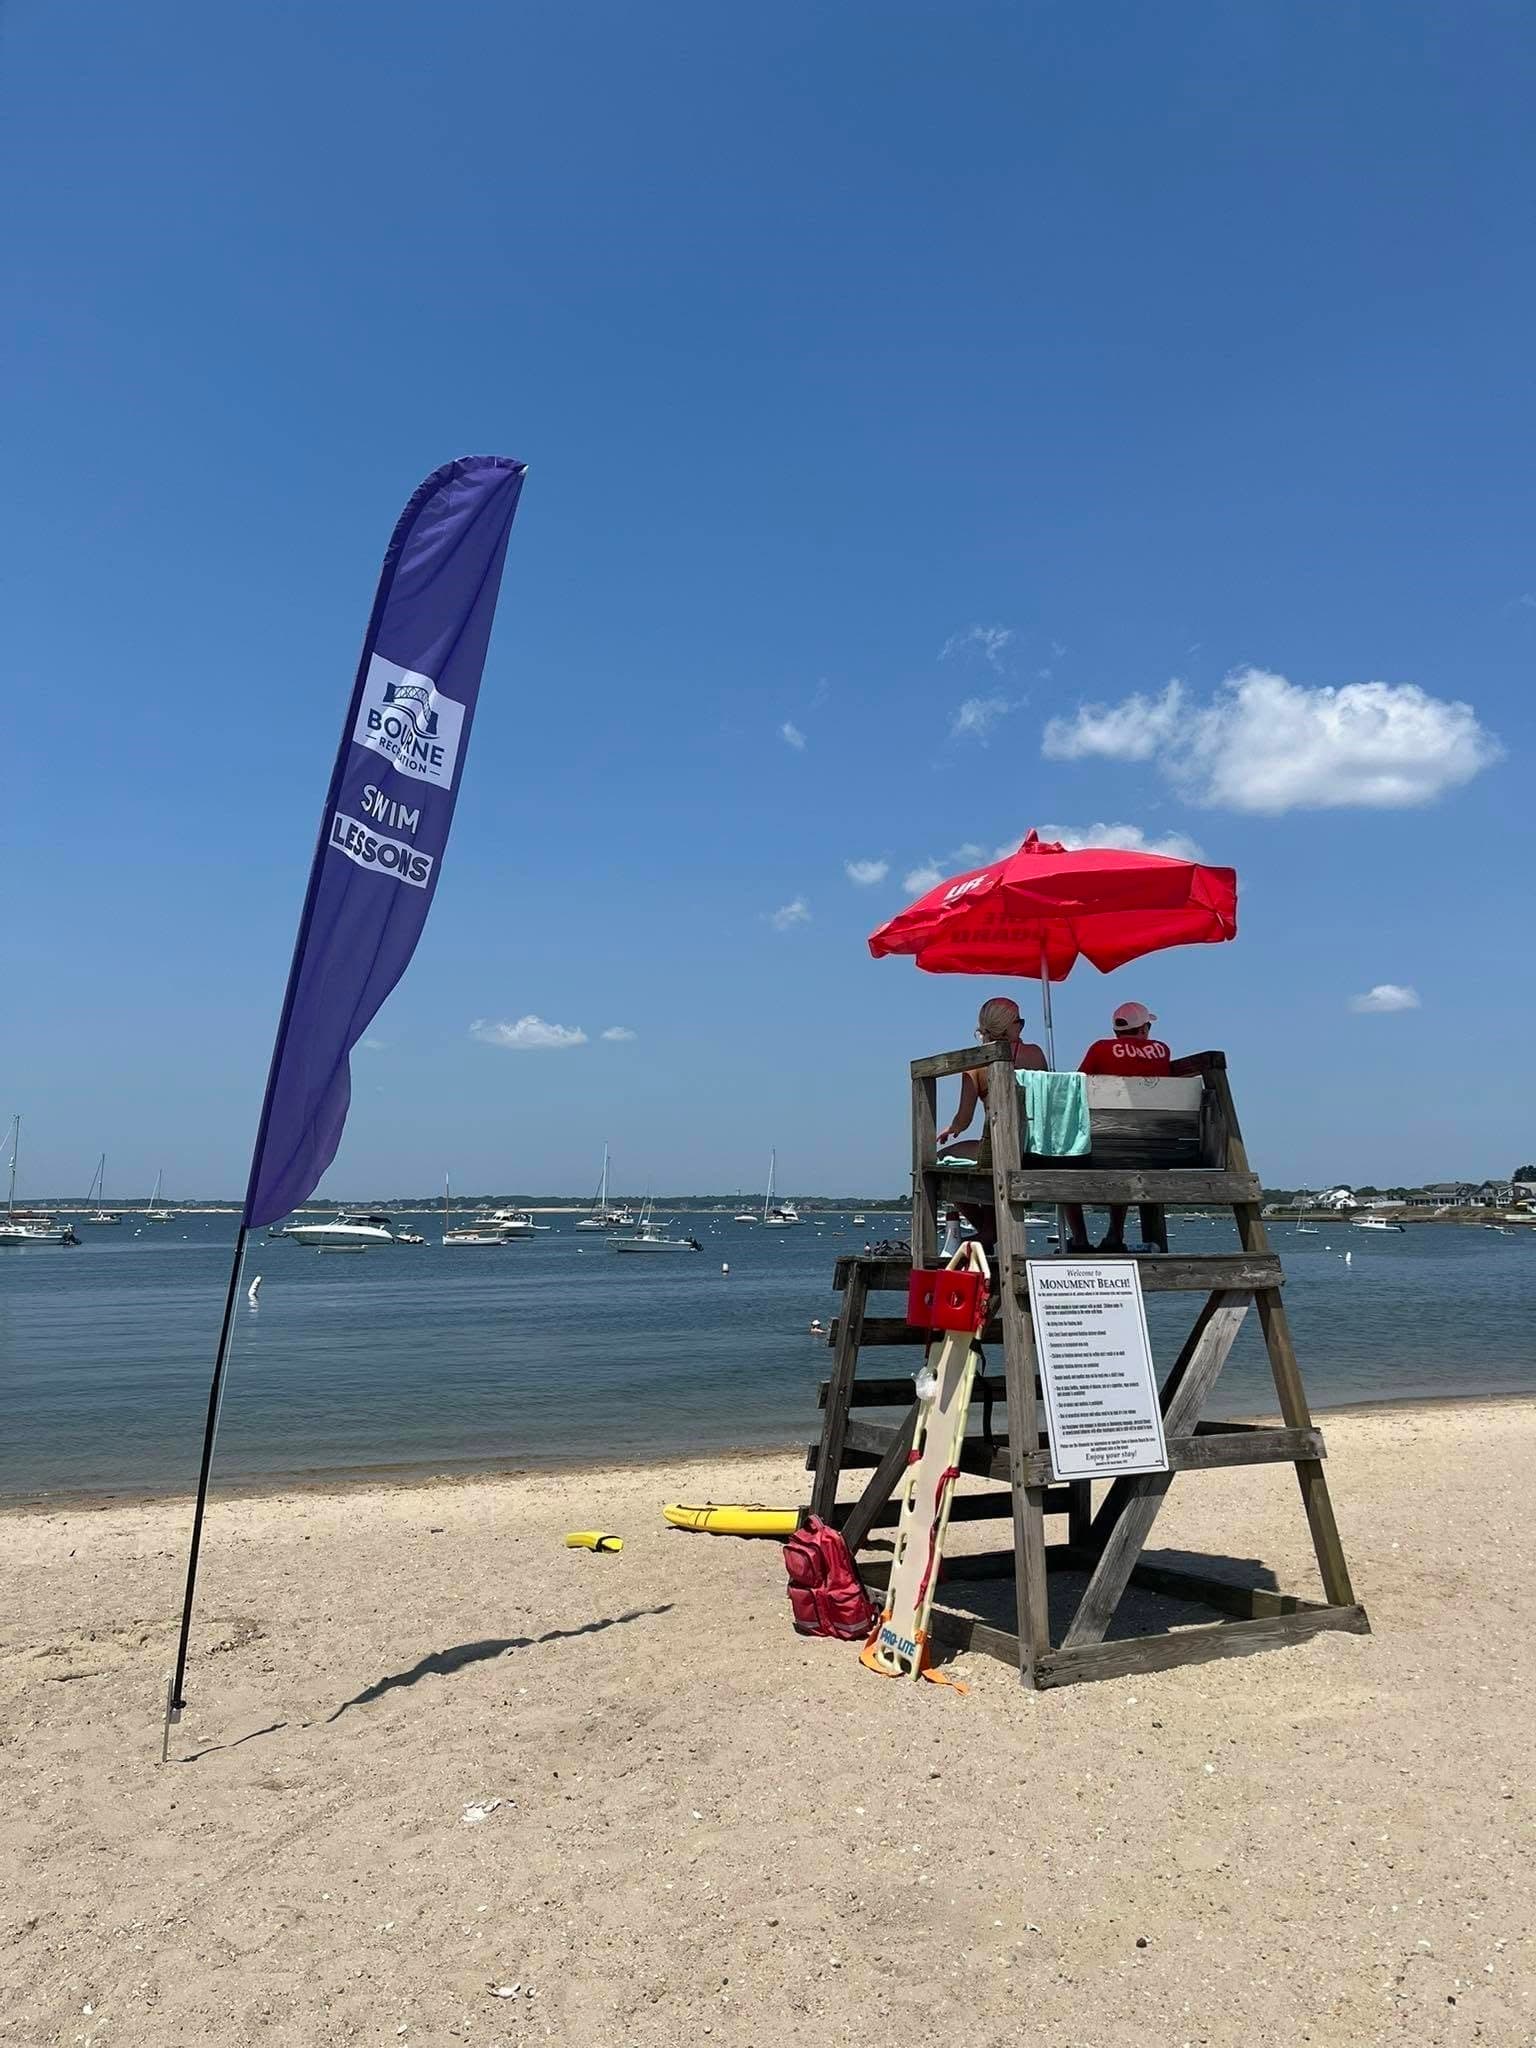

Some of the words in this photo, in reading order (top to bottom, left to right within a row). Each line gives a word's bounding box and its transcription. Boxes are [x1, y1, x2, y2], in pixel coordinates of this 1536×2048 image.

[367, 708, 445, 767] BOURNE
[379, 736, 427, 774] RECTION
[360, 784, 420, 835] SWIM
[332, 817, 430, 882] LESSONS
[1112, 1043, 1166, 1059] GUARD
[1040, 1279, 1095, 1289] MONUMENT
[1097, 1278, 1130, 1288] BEACH!
[1066, 1269, 1094, 1277] Welcome
[1085, 1453, 1104, 1461] Enjoy
[1106, 1452, 1120, 1460] your
[1121, 1450, 1137, 1459] stay!
